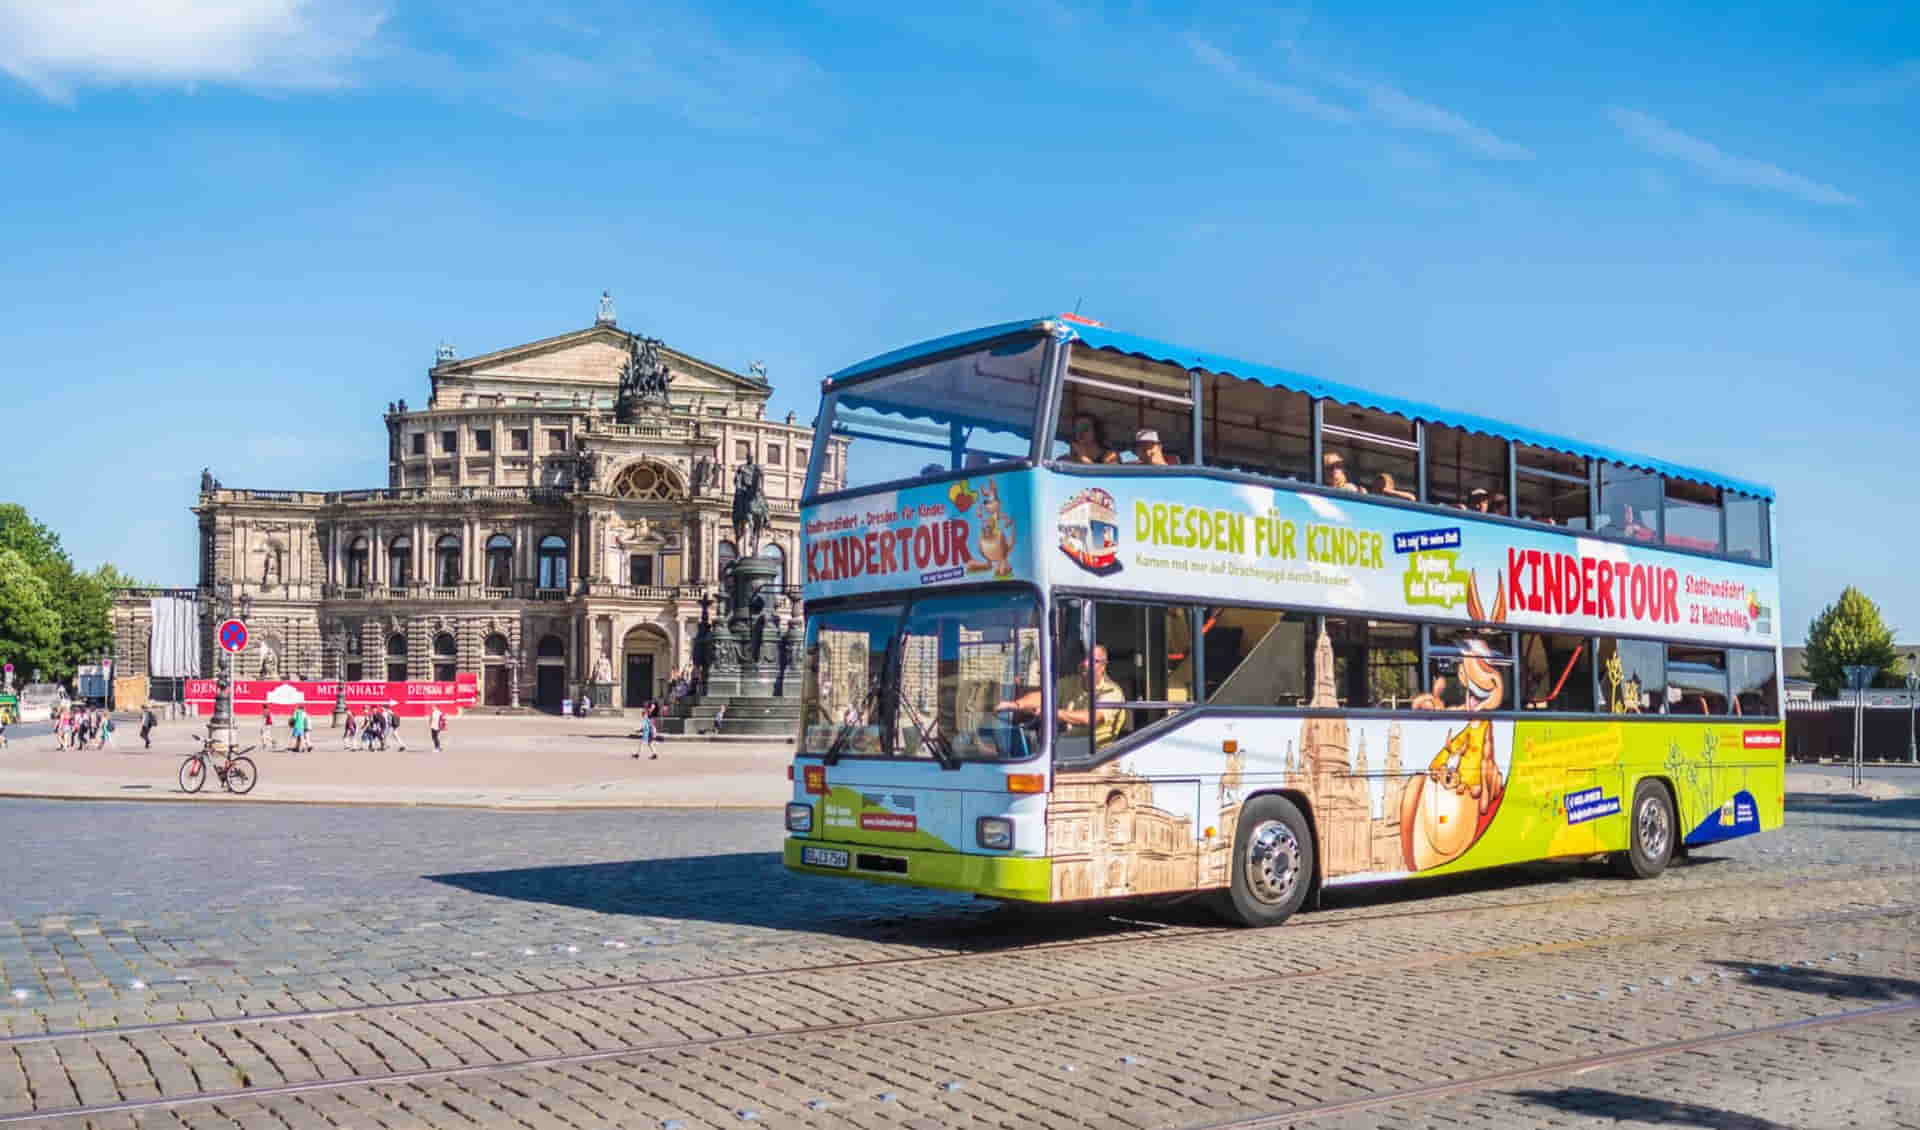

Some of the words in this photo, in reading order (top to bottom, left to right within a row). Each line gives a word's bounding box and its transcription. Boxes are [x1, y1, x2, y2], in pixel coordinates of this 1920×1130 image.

[806, 519, 973, 583] KINDERTOUR
[1135, 500, 1245, 554] DRESDEN
[1254, 508, 1296, 560] FÜR
[1306, 523, 1384, 569] KINDER
[1508, 547, 1679, 625] KINDERTOUR
[1685, 575, 1745, 600] Stadtrundfahrt
[1690, 603, 1699, 624] 22
